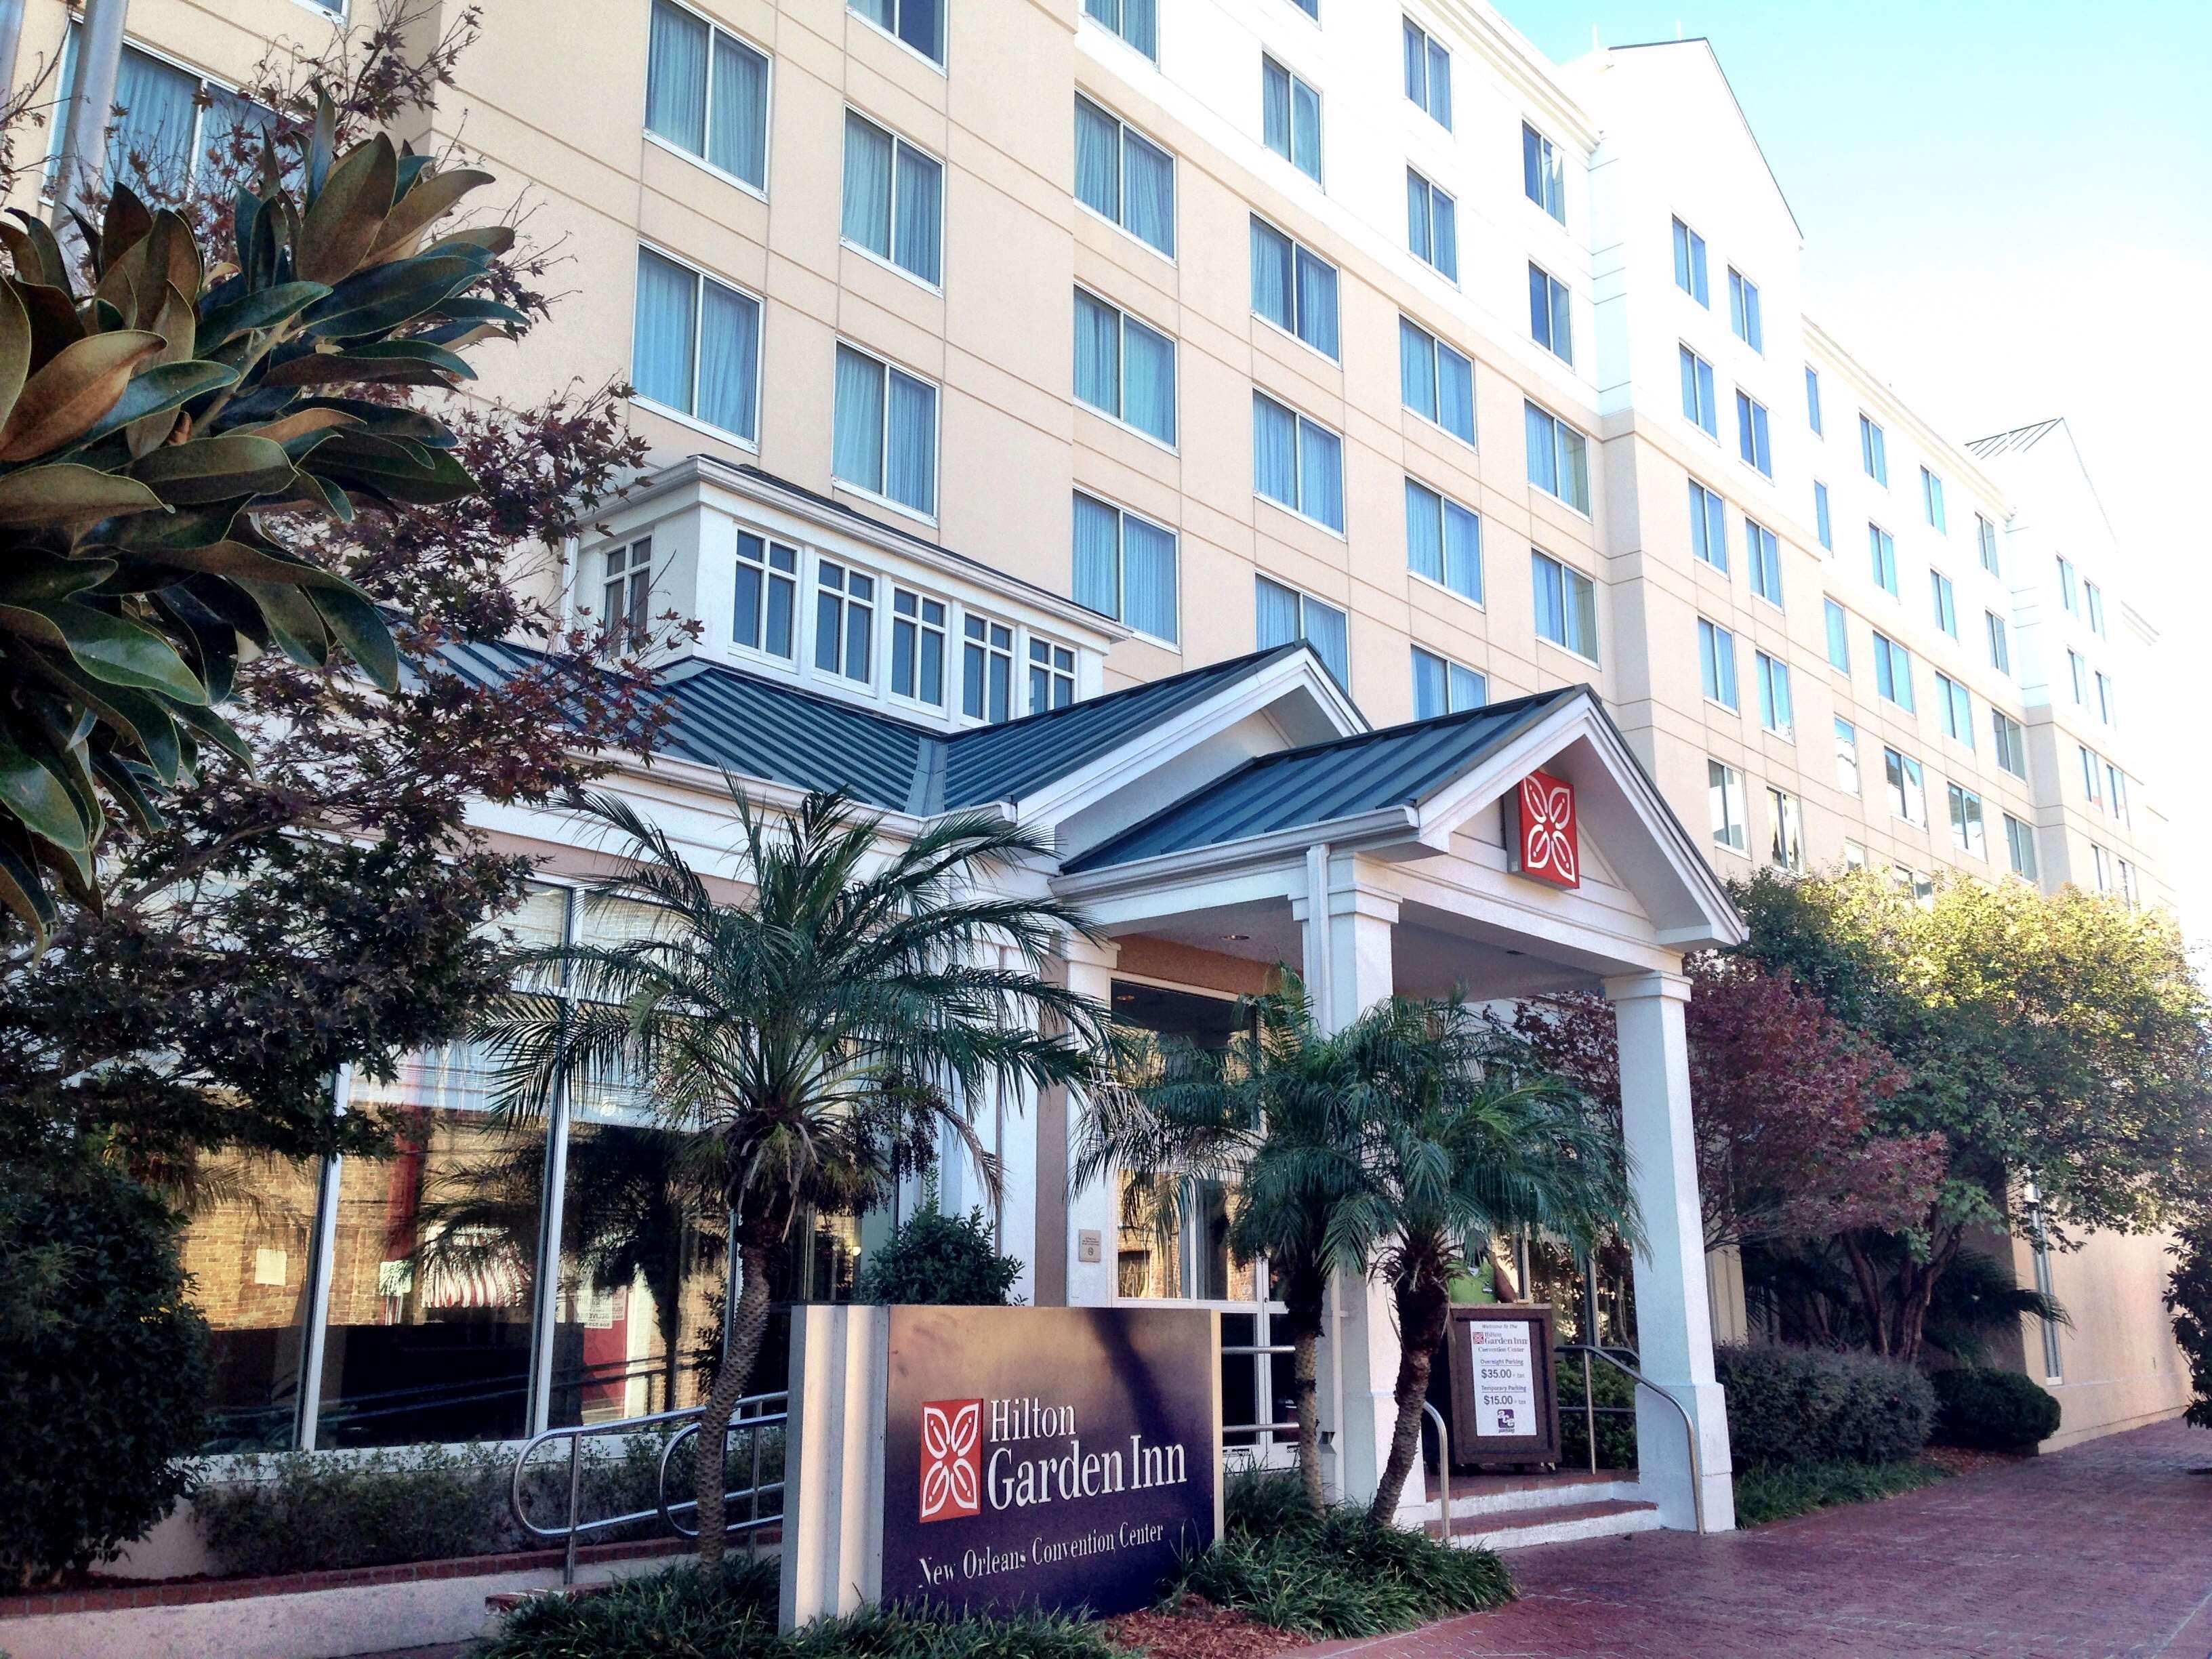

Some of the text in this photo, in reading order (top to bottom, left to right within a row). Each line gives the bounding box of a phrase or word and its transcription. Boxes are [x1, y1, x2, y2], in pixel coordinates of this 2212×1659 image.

[1484, 1336, 1513, 1345] Garden
[1481, 1369, 1512, 1379] $35.00
[1483, 1395, 1513, 1406] $15.00
[989, 1397, 1076, 1443] Hilton
[987, 1434, 1187, 1511] Garden Inn
[918, 1521, 1164, 1589] New Orleans Convention Center
